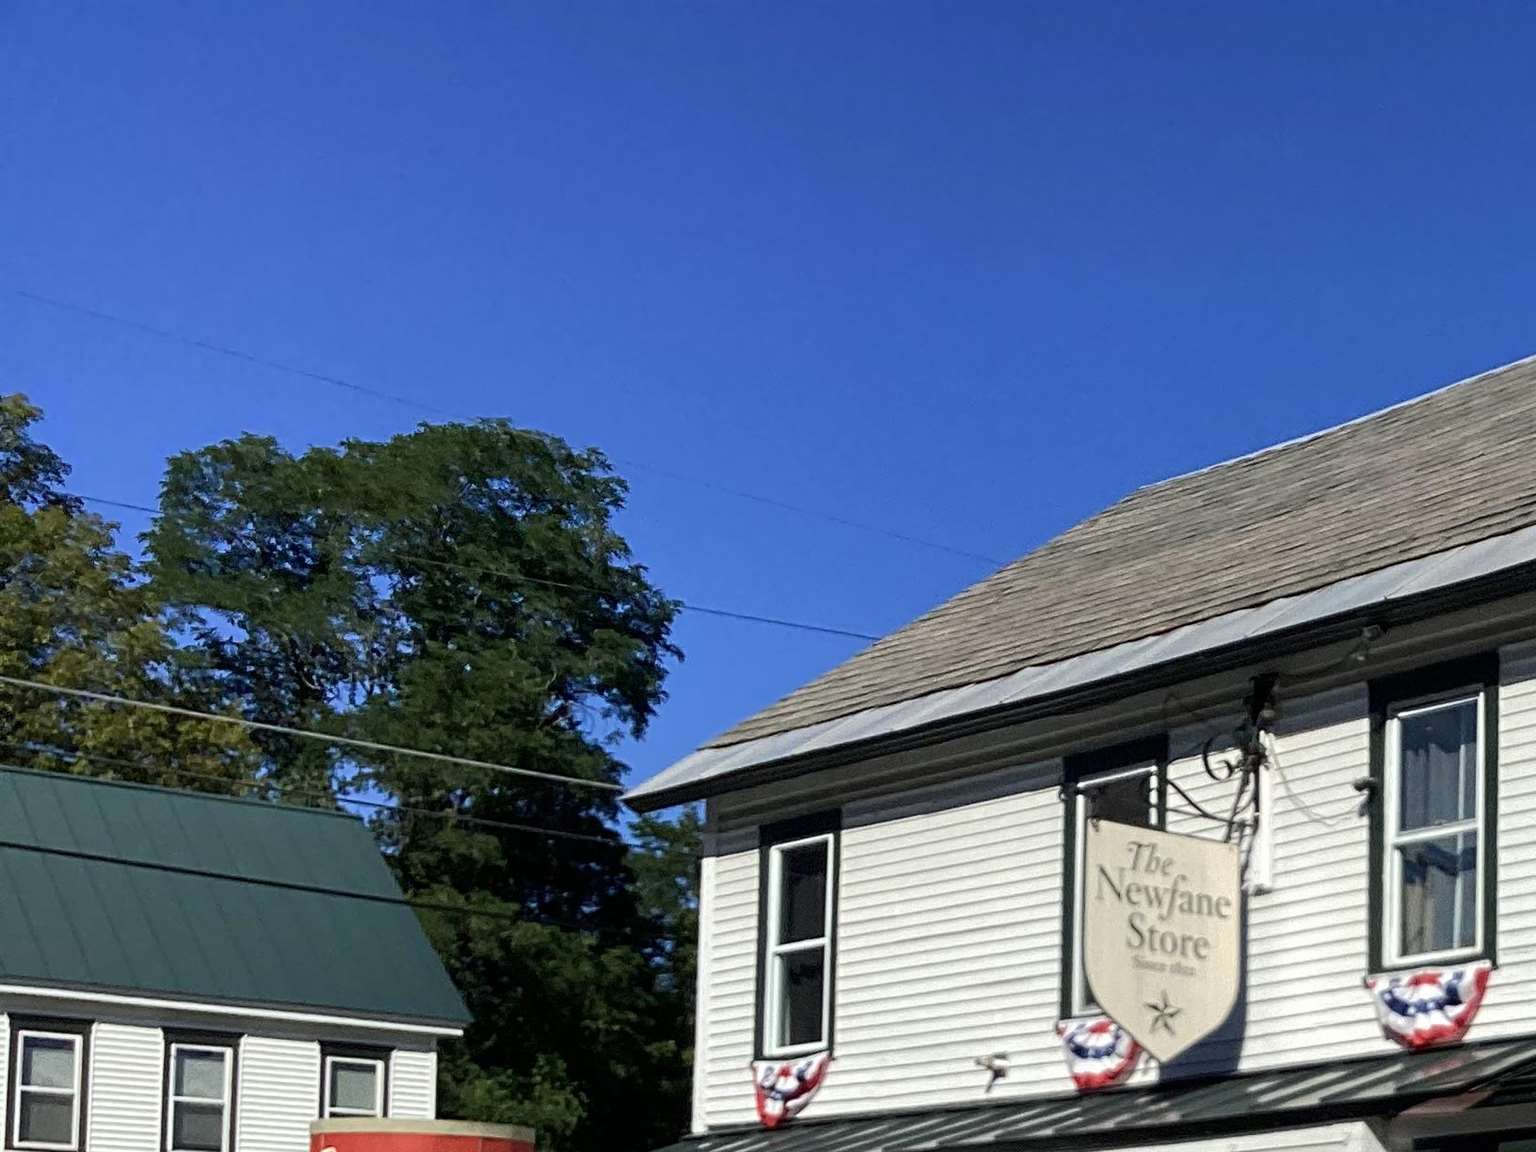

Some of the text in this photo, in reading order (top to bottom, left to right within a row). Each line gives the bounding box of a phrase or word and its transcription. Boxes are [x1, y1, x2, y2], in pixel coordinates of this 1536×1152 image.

[1128, 841, 1174, 874] The
[1097, 864, 1231, 920] Newfane
[1126, 911, 1211, 960] Store
